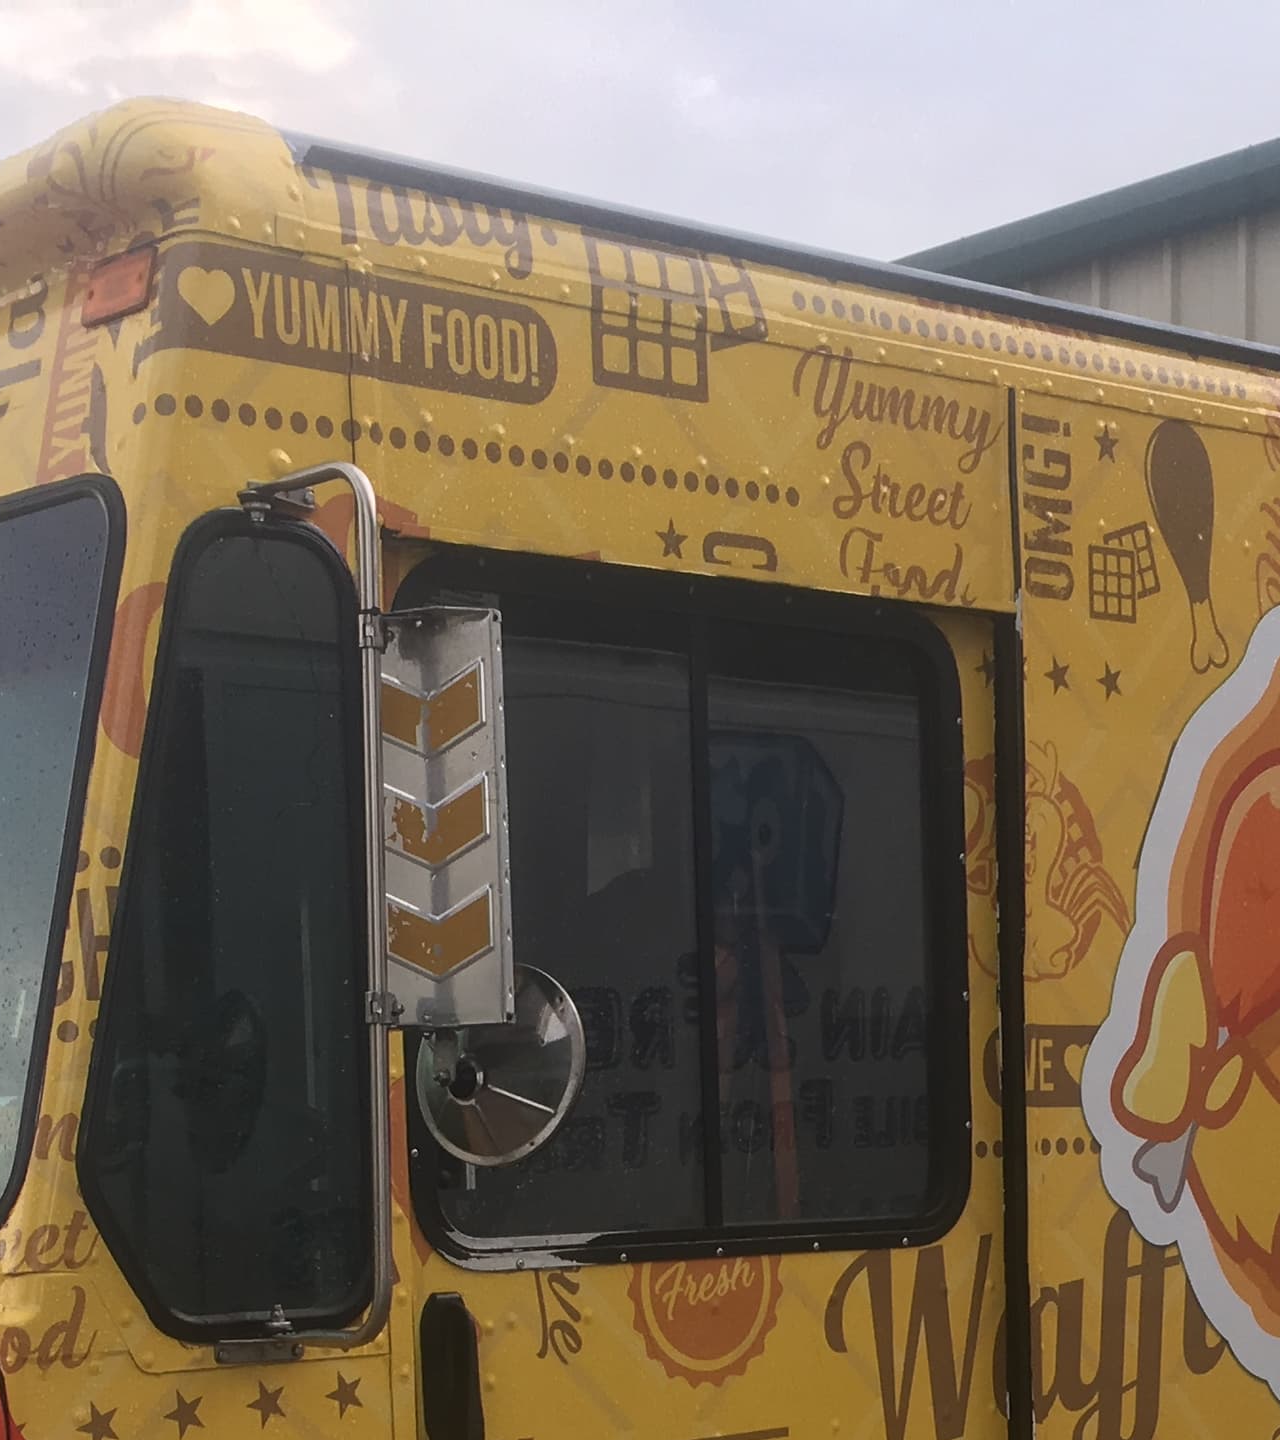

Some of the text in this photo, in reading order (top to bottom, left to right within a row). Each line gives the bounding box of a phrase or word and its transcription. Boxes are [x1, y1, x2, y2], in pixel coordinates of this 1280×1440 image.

[241, 267, 540, 387] YUMMY FOOD!
[792, 345, 1005, 474] Yummy
[832, 440, 973, 530] Street
[1022, 412, 1074, 601] OMG!
[655, 1256, 756, 1321] Fresh
